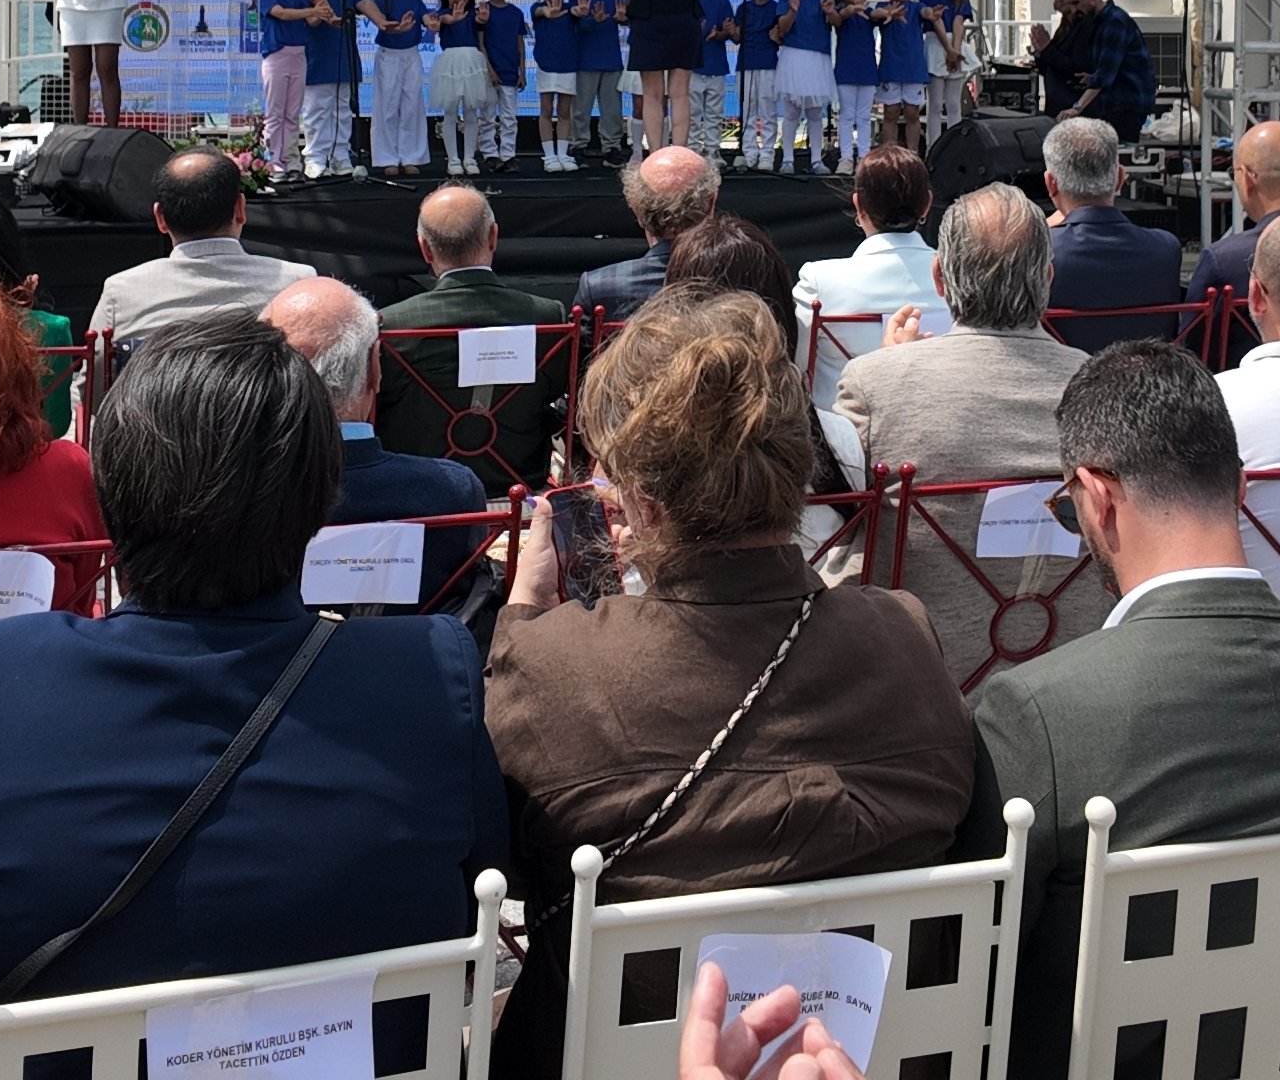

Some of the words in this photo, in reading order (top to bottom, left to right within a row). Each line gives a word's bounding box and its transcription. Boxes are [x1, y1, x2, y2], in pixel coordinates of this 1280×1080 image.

[845, 995, 872, 1014] SAYIN
[166, 1051, 204, 1067] KODER
[206, 1040, 253, 1060] YÖNETİM
[255, 1032, 296, 1051] KURULU
[298, 1027, 321, 1042] BŞK.
[323, 1020, 353, 1035] SAYIN
[219, 1055, 269, 1070] TACETTİN
[271, 1046, 305, 1062] ÖZDEN
